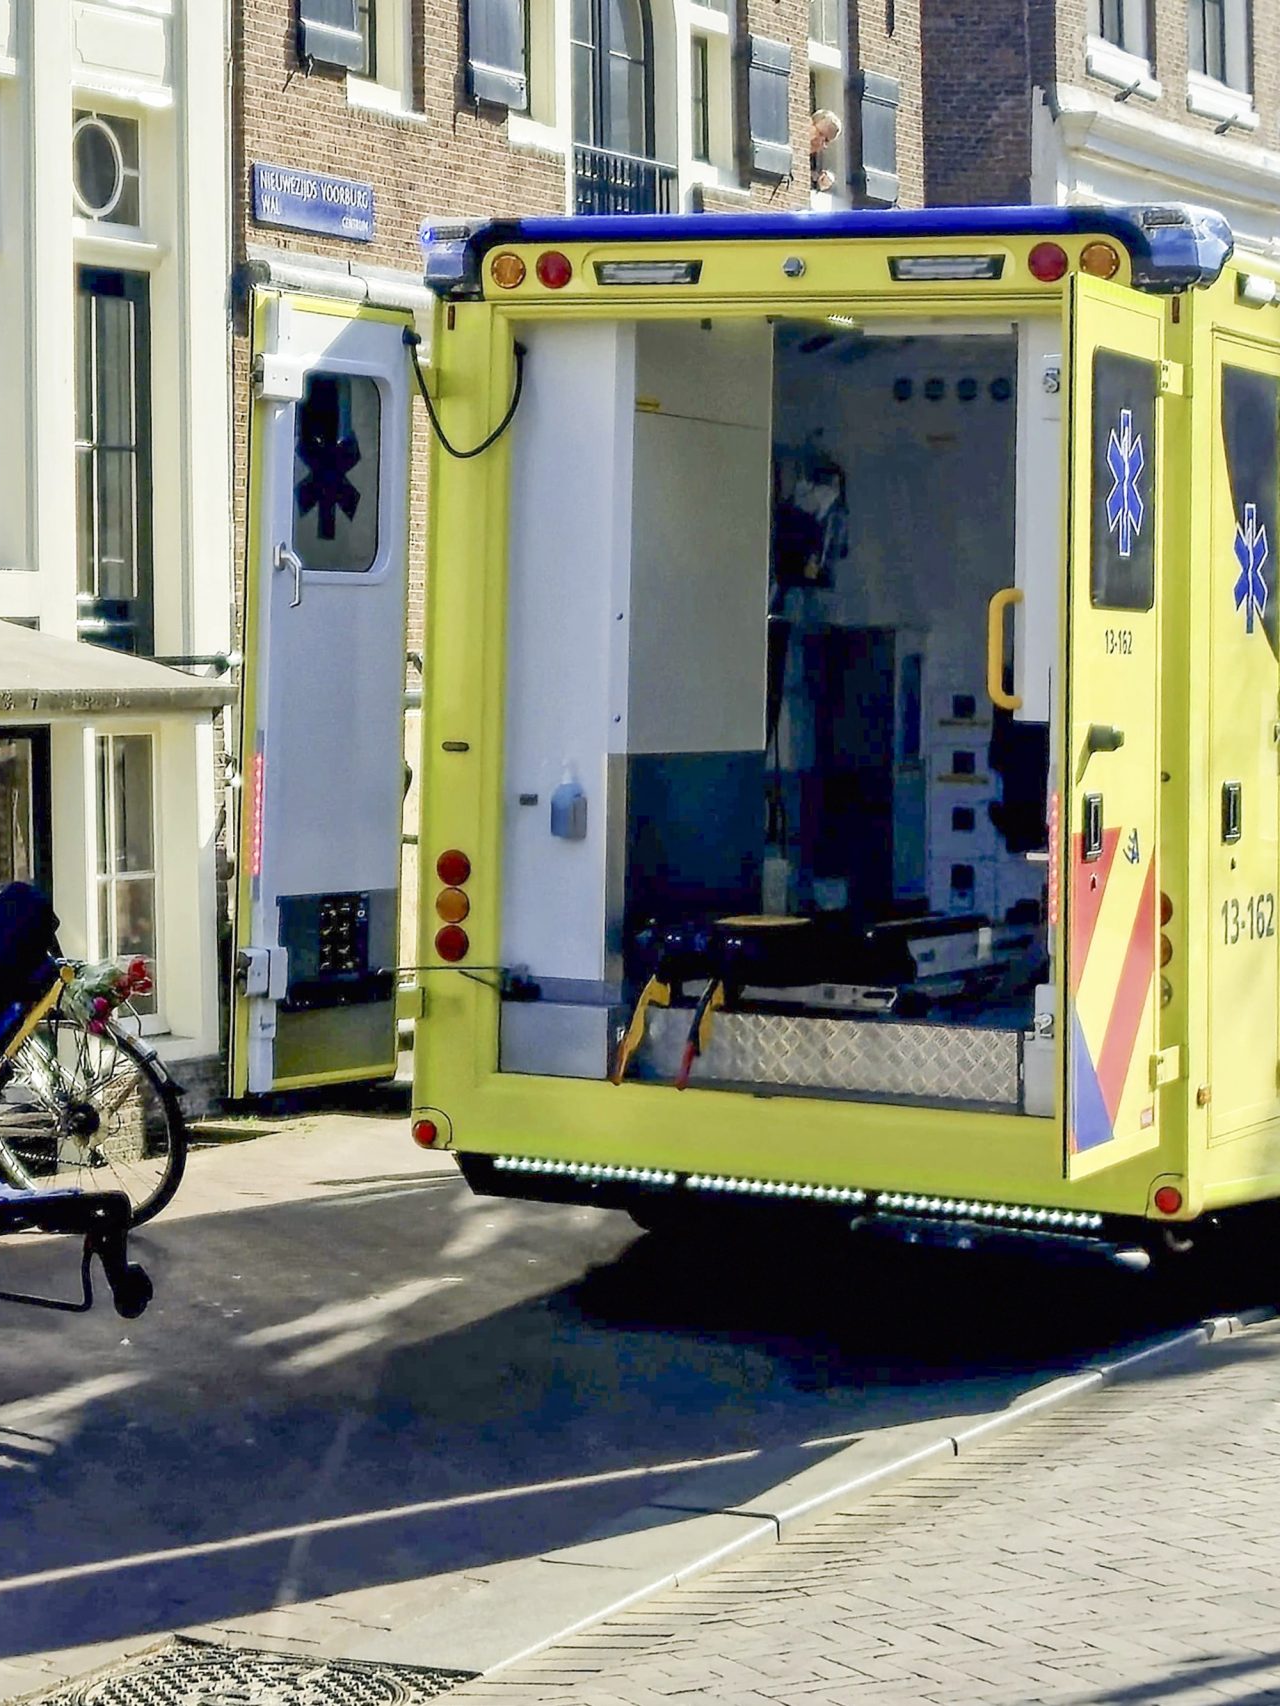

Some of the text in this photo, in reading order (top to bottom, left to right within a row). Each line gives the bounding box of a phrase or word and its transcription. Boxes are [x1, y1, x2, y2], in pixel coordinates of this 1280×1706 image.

[260, 169, 369, 209] NIEUWEZIJDS VOORBURG
[261, 194, 280, 215] WAL
[341, 216, 369, 232] CENTRUM
[1105, 629, 1132, 654] 13-162
[1221, 893, 1274, 945] 13-162
